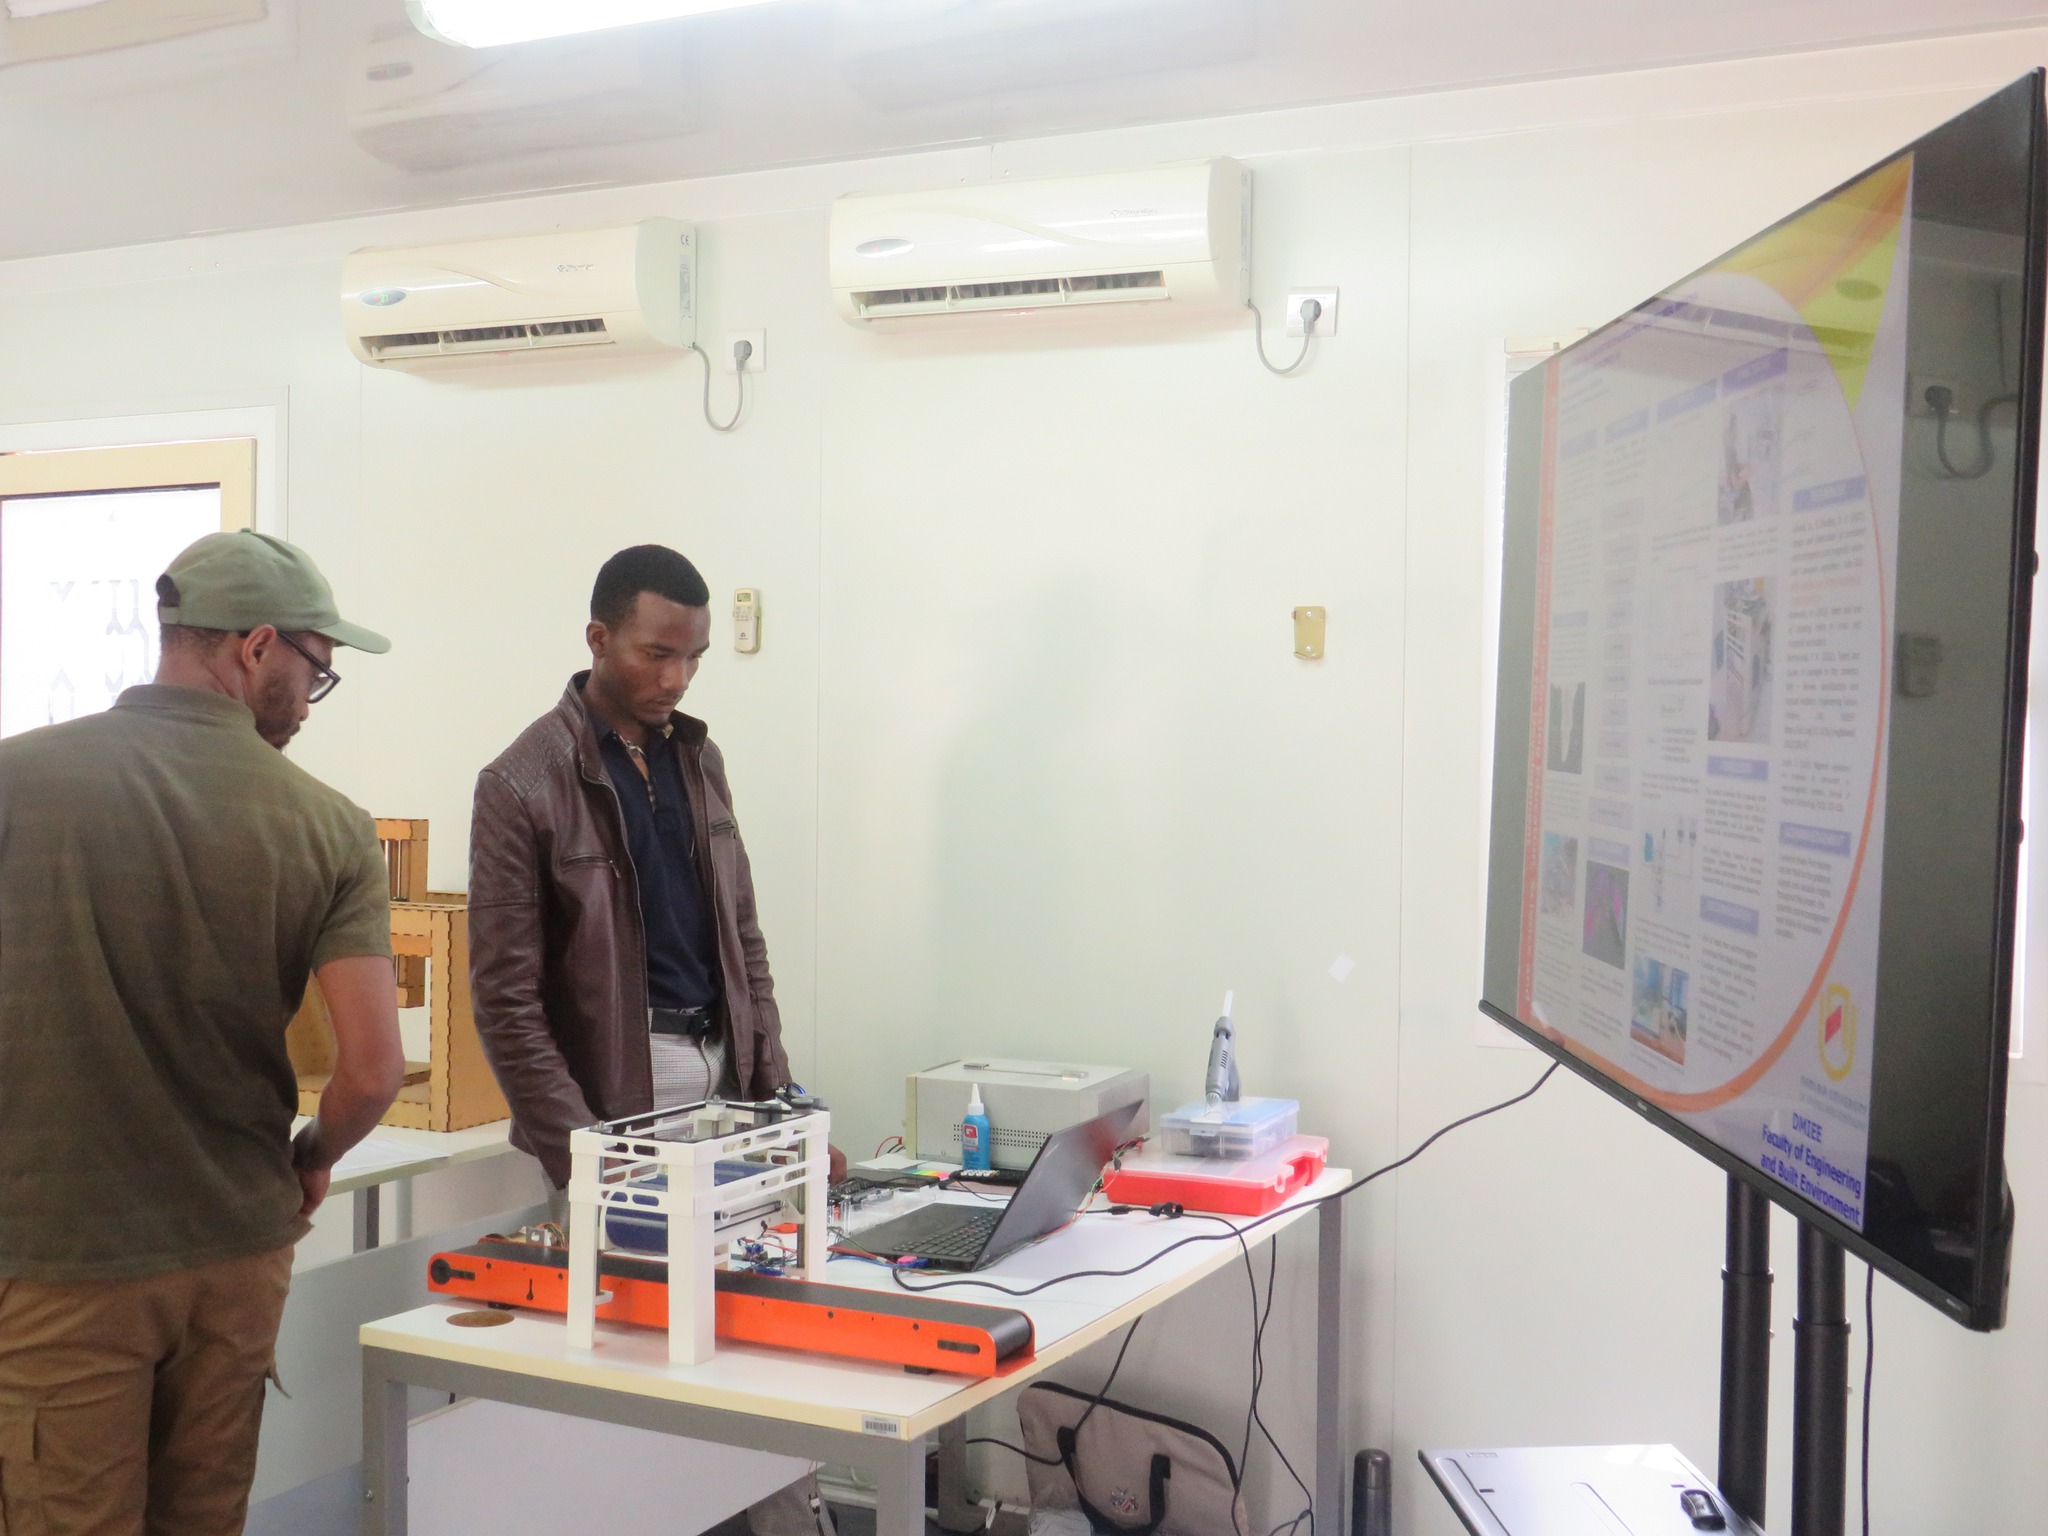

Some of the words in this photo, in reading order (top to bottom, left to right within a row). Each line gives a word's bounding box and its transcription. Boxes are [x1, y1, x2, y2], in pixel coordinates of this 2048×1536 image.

[1762, 1124, 1792, 1159] Faculty
[1794, 1144, 1804, 1161] of
[1806, 1149, 1861, 1198] Engineering
[1792, 1112, 1823, 1143] DMIEE
[1760, 1153, 1776, 1173] and
[1778, 1160, 1798, 1188] Built
[1800, 1175, 1860, 1225] Environment
